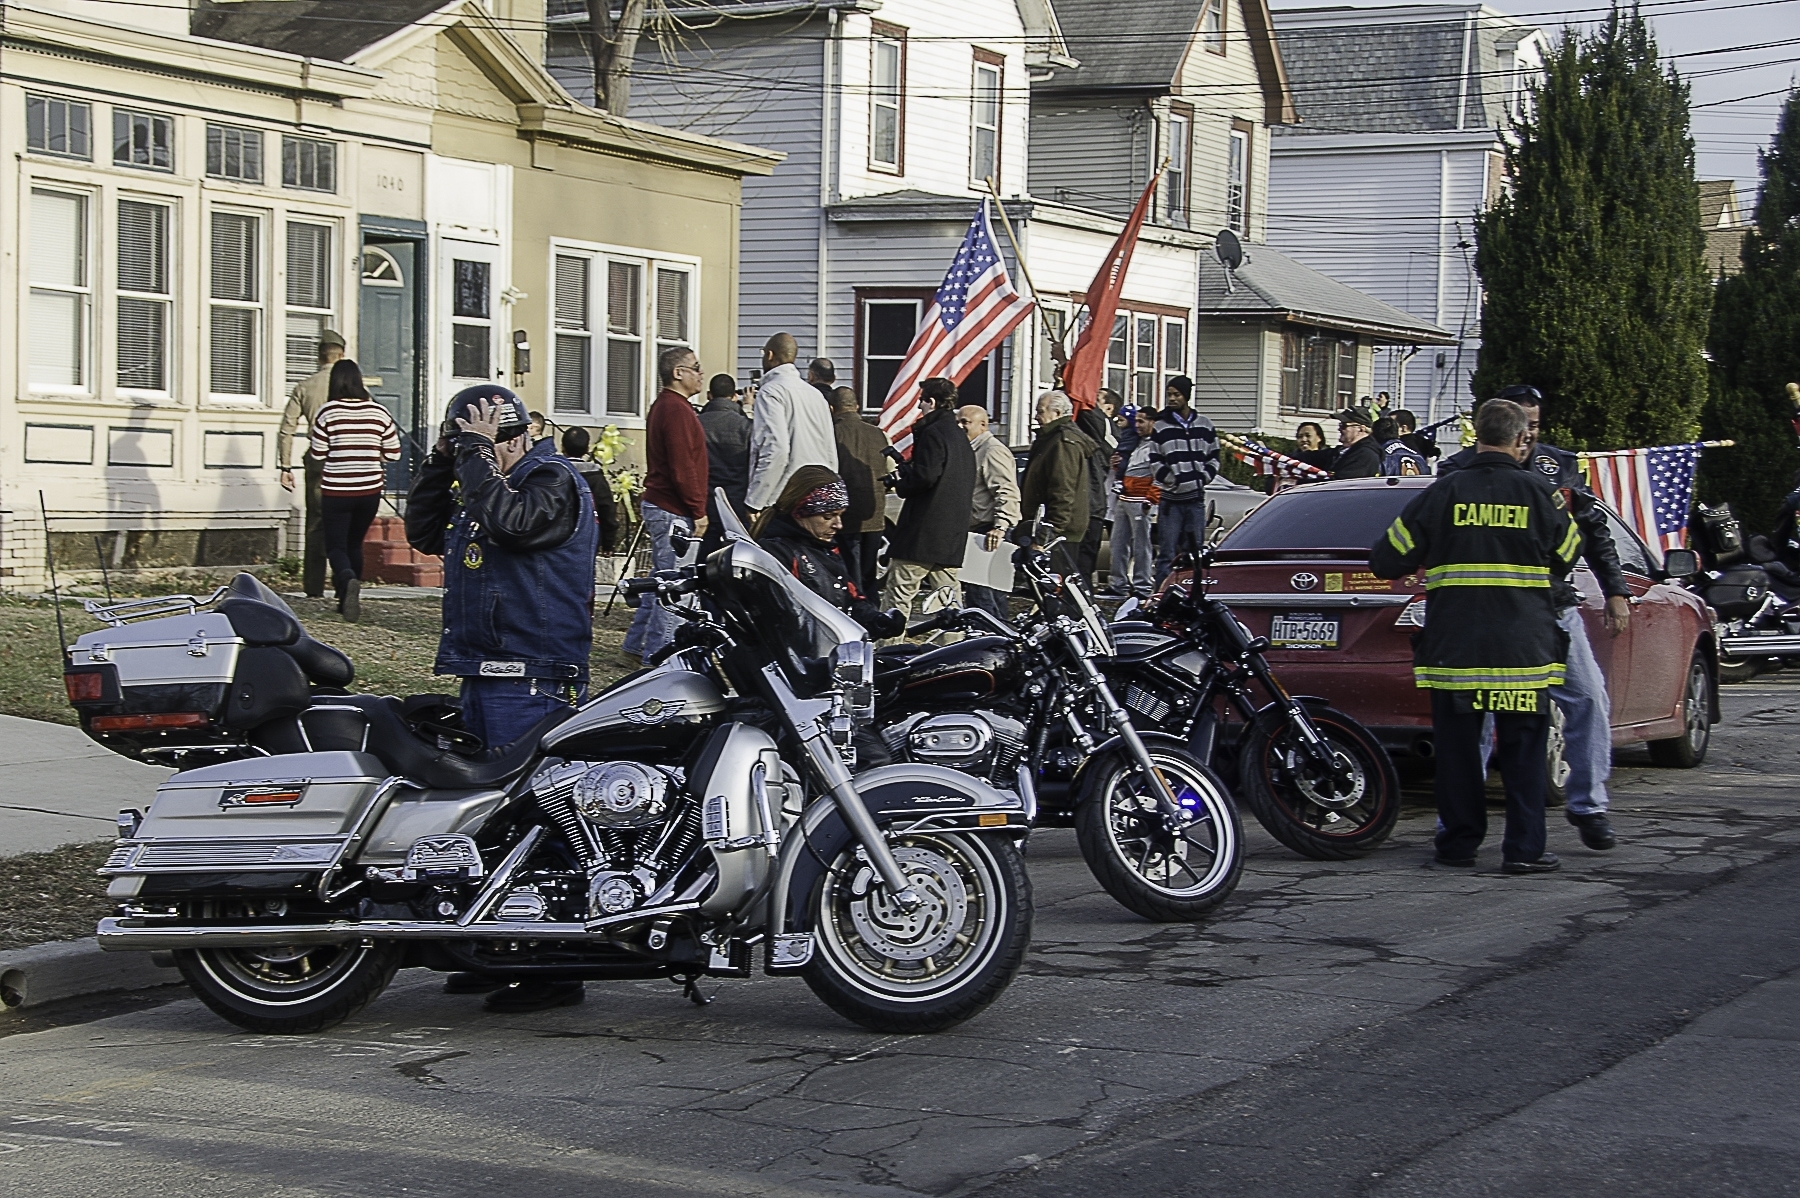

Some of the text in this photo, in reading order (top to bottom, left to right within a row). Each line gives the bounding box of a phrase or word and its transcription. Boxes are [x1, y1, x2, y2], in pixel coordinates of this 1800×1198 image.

[377, 174, 404, 191] 1040
[1454, 503, 1529, 528] CAMDEN
[1472, 690, 1537, 712] J FAYER
